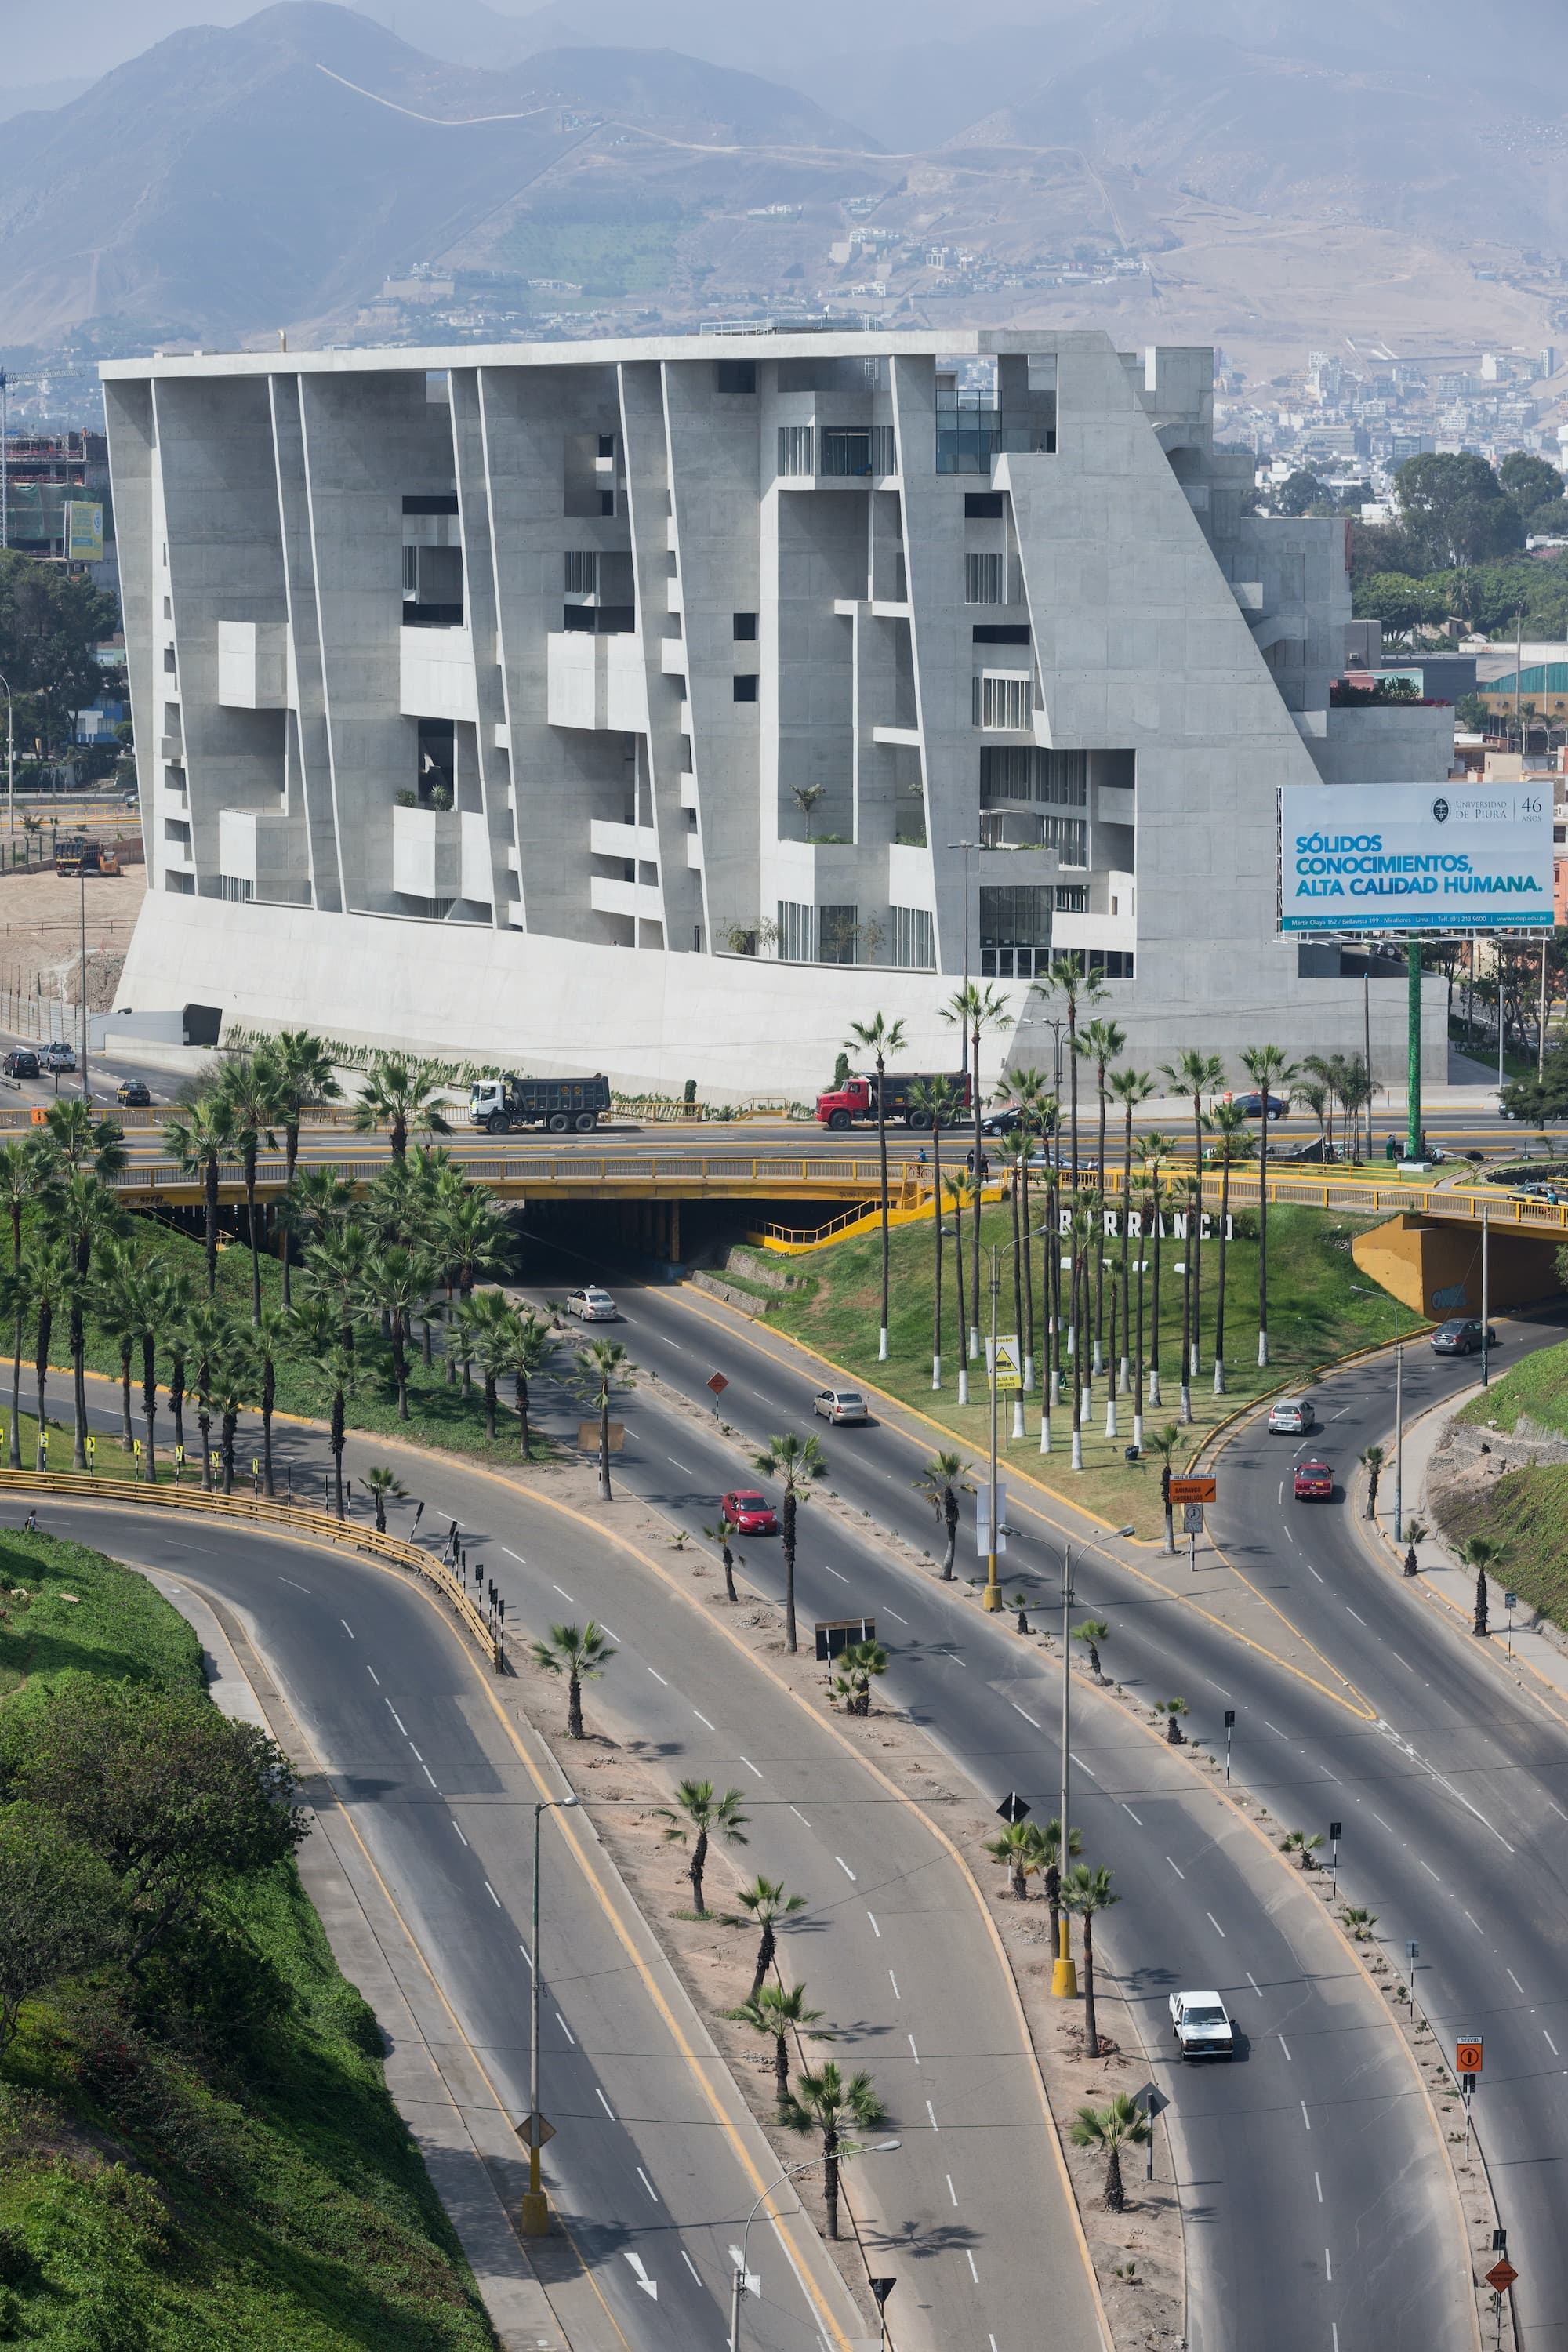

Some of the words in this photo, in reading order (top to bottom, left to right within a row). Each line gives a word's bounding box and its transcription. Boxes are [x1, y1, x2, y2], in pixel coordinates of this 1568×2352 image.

[1455, 811, 1468, 819] DE
[1475, 809, 1507, 819] PIURA
[1521, 797, 1542, 813] 46
[1521, 814, 1541, 822] AÑOS
[1295, 832, 1382, 854] SÓLIDOS
[1295, 854, 1474, 876] CONOCIMIENTOS,
[1295, 879, 1345, 897] ALTA
[1349, 877, 1439, 896] CALIDAD
[1443, 875, 1543, 894] HUMANA.
